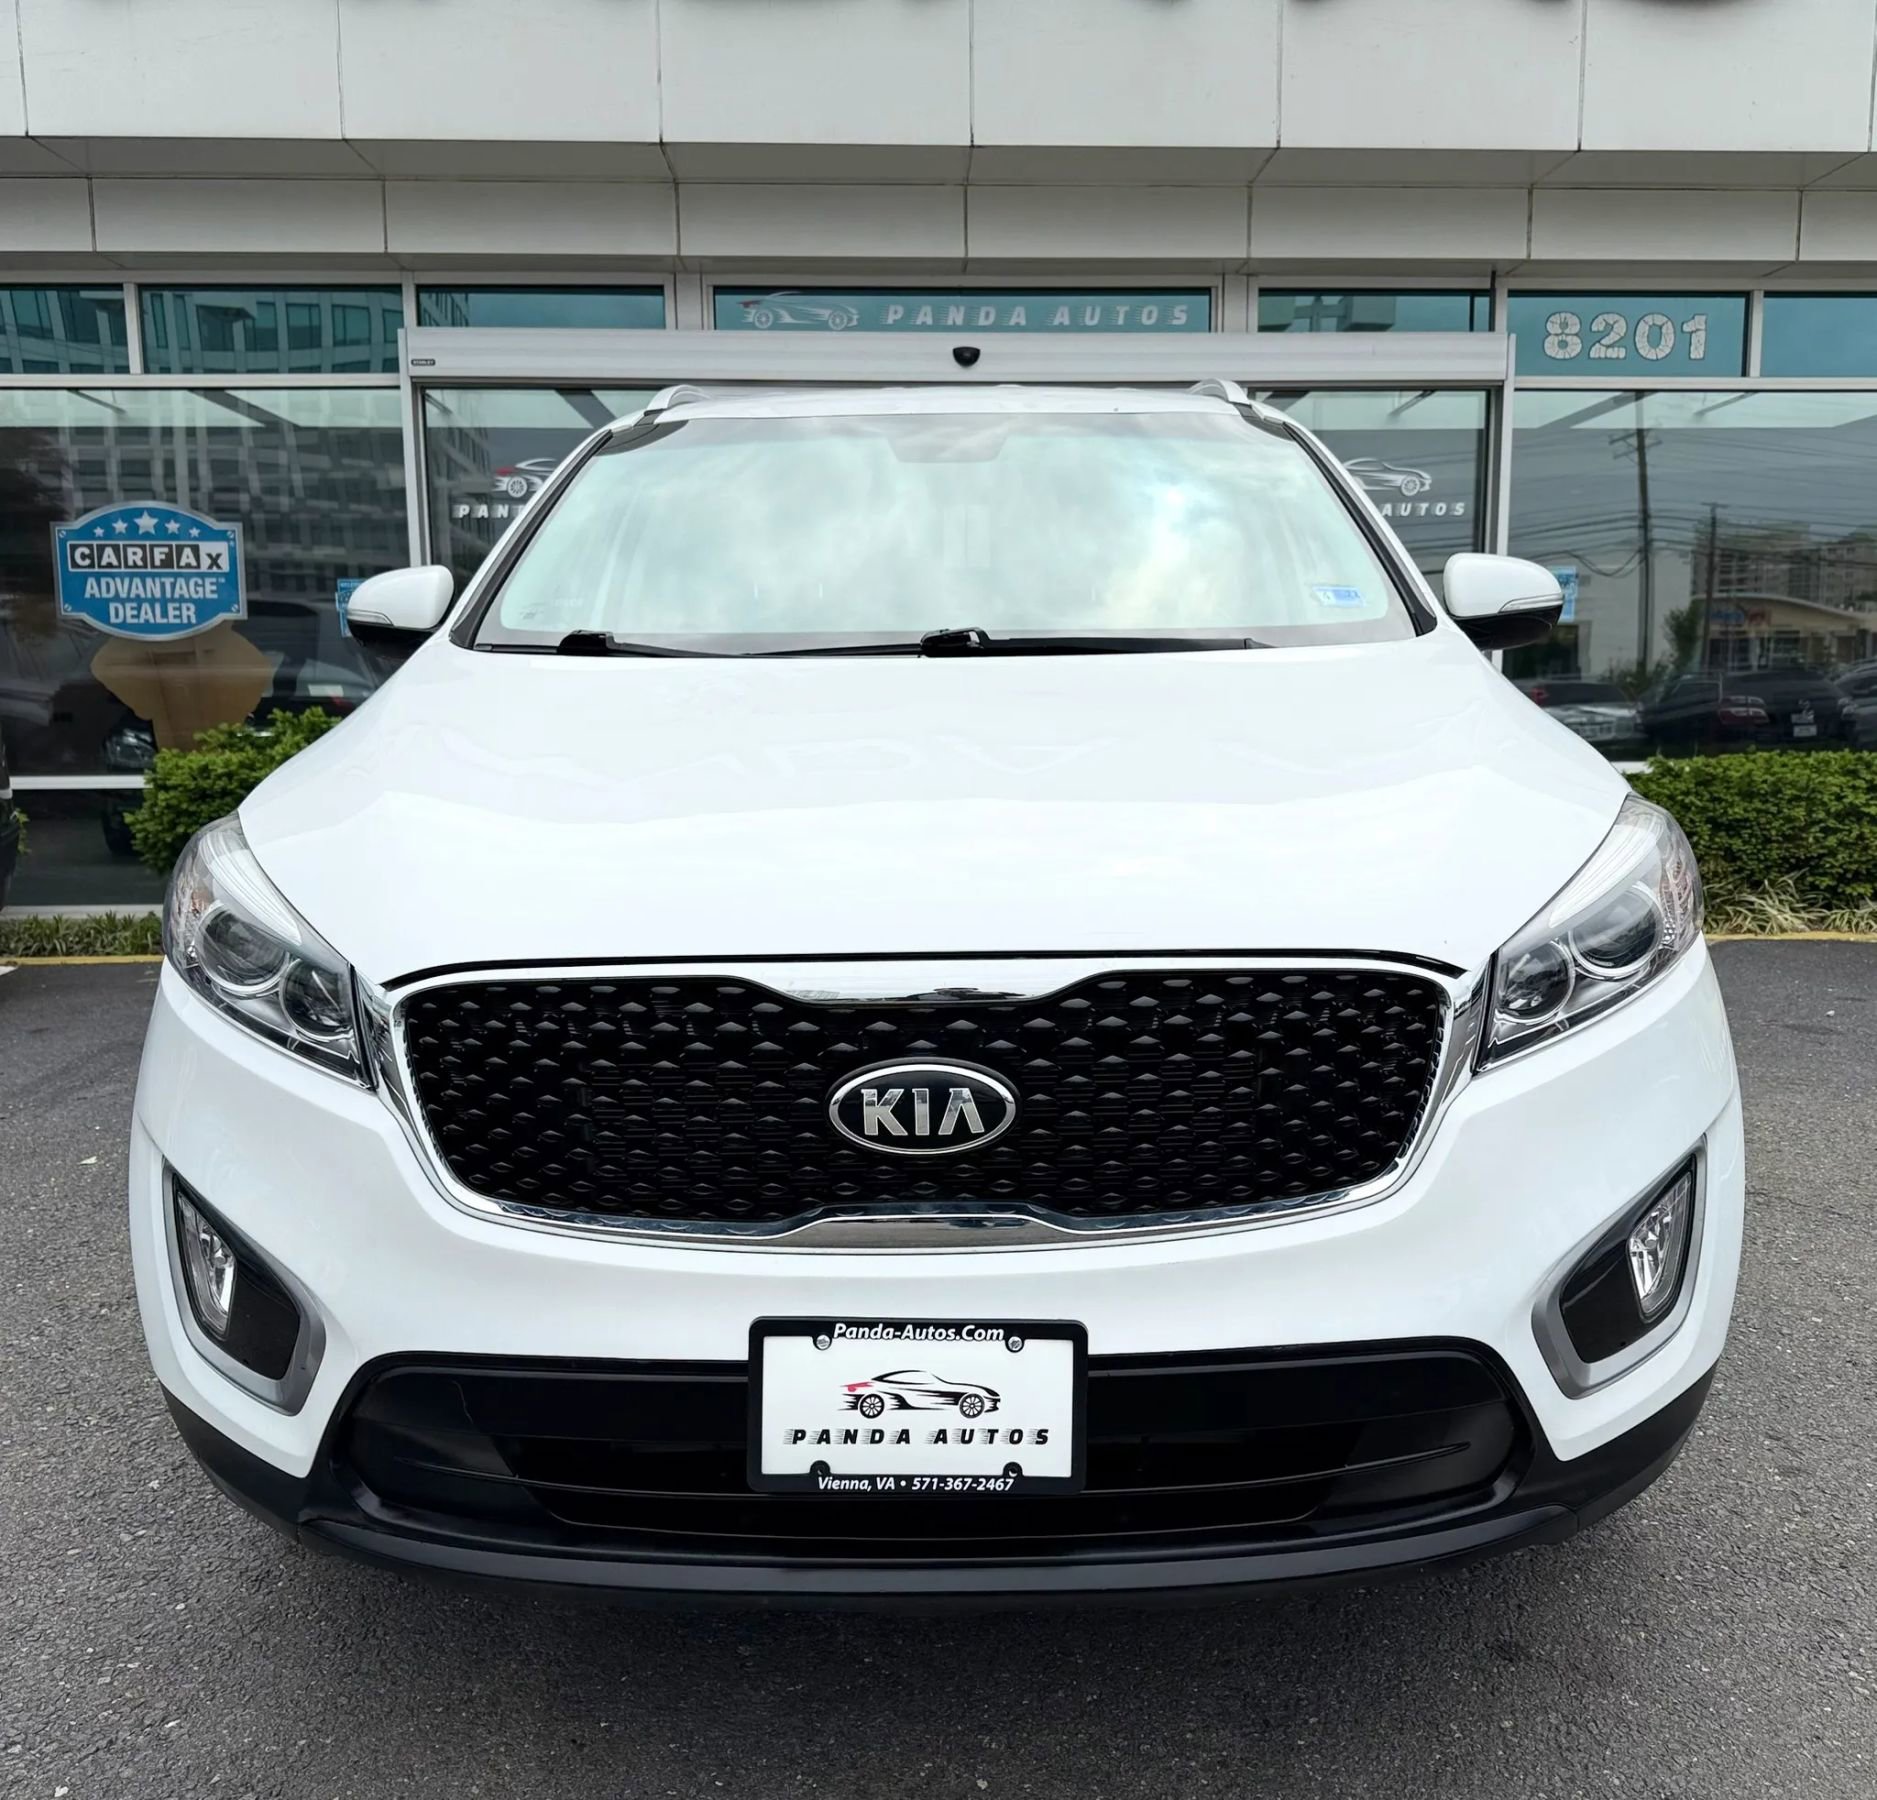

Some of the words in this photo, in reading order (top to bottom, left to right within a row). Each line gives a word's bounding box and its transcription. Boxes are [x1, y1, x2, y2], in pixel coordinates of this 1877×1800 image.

[886, 304, 1027, 326] PANDA
[1053, 304, 1188, 326] AUTOS
[1543, 311, 1707, 360] 8201
[457, 504, 526, 518] PAN
[1381, 502, 1465, 517] AUTOS
[73, 546, 223, 570] CARFAX
[109, 602, 197, 624] DEALER
[860, 1088, 985, 1136] KIA
[833, 1323, 1005, 1342] Panda-Autos.Com
[790, 1428, 911, 1445] PANDA
[931, 1428, 1049, 1445] AUTOS
[817, 1476, 872, 1492] Vienna,
[875, 1477, 896, 1490] VA
[911, 1477, 1014, 1491] 571-367-2467
